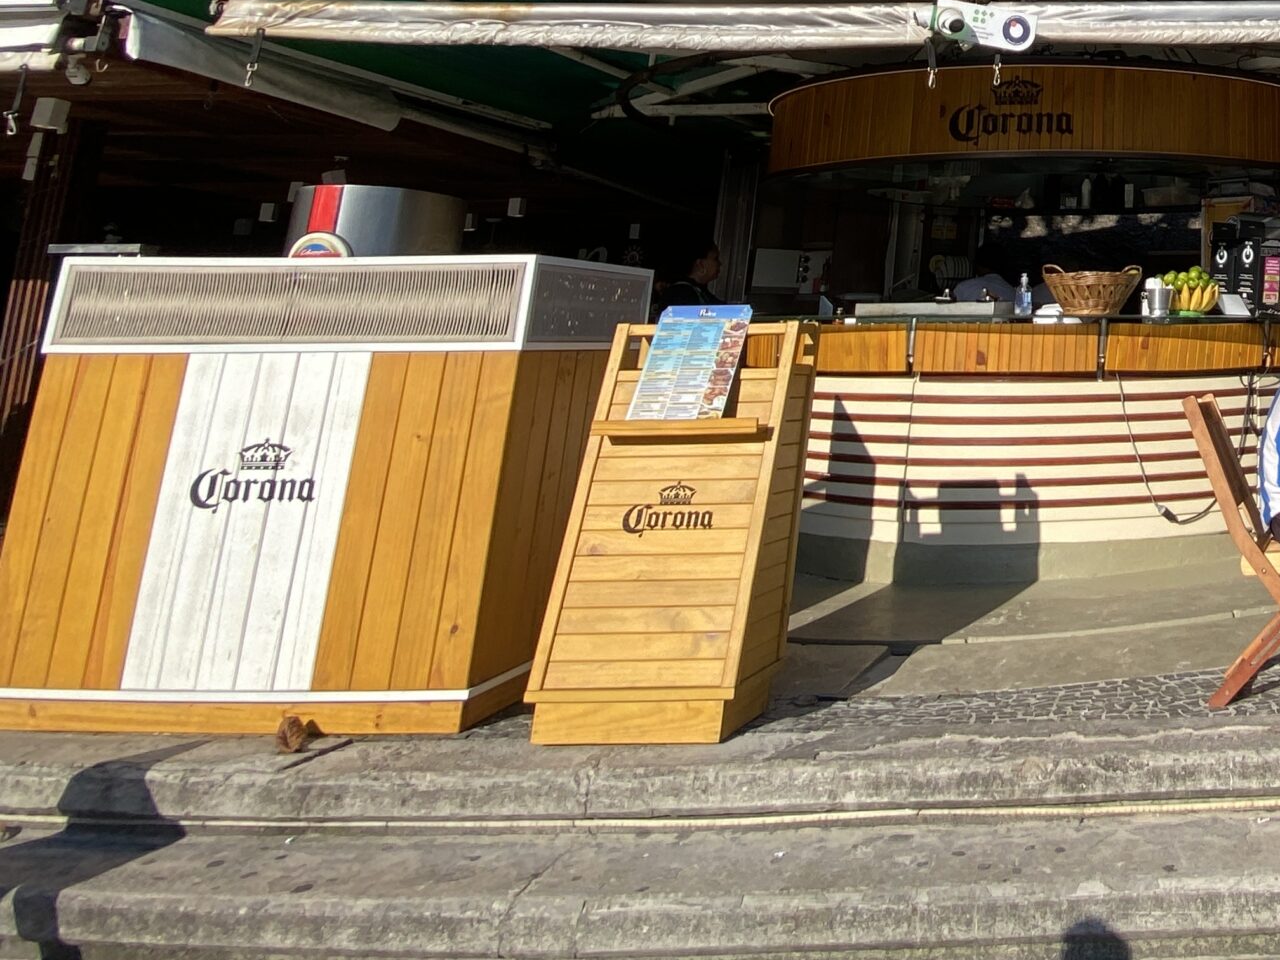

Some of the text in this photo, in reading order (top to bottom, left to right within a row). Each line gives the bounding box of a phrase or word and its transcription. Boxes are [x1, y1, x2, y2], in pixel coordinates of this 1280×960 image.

[948, 103, 1074, 146] Corona
[189, 468, 315, 514] Corona
[622, 504, 714, 538] Corona
